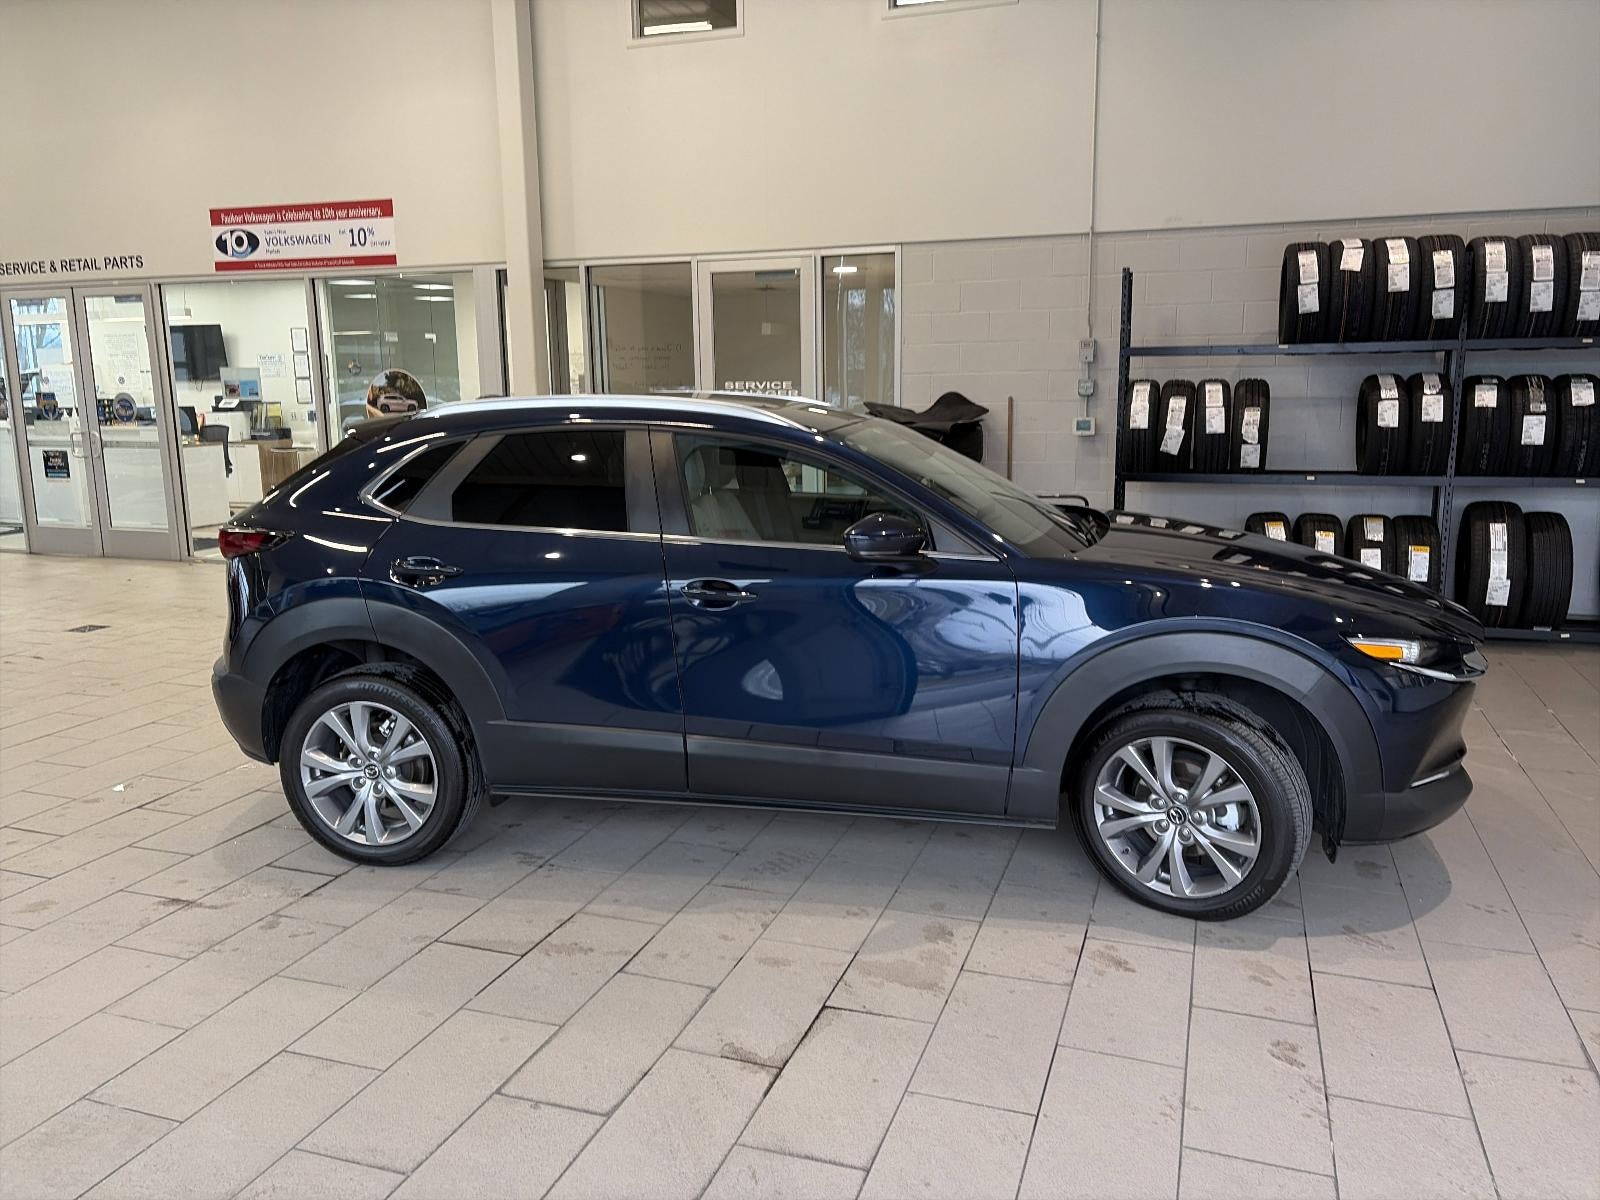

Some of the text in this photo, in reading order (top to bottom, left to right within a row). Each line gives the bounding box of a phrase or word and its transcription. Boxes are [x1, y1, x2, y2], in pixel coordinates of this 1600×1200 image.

[243, 211, 275, 224] Volkswagen
[282, 208, 313, 222] Celebrating
[322, 206, 336, 220] 10th
[220, 229, 249, 257] 10
[264, 233, 331, 248] VOLKSWAGEN
[0, 255, 144, 276] SERVICE & RETAIL PARTS
[724, 380, 793, 390] SERVICE
